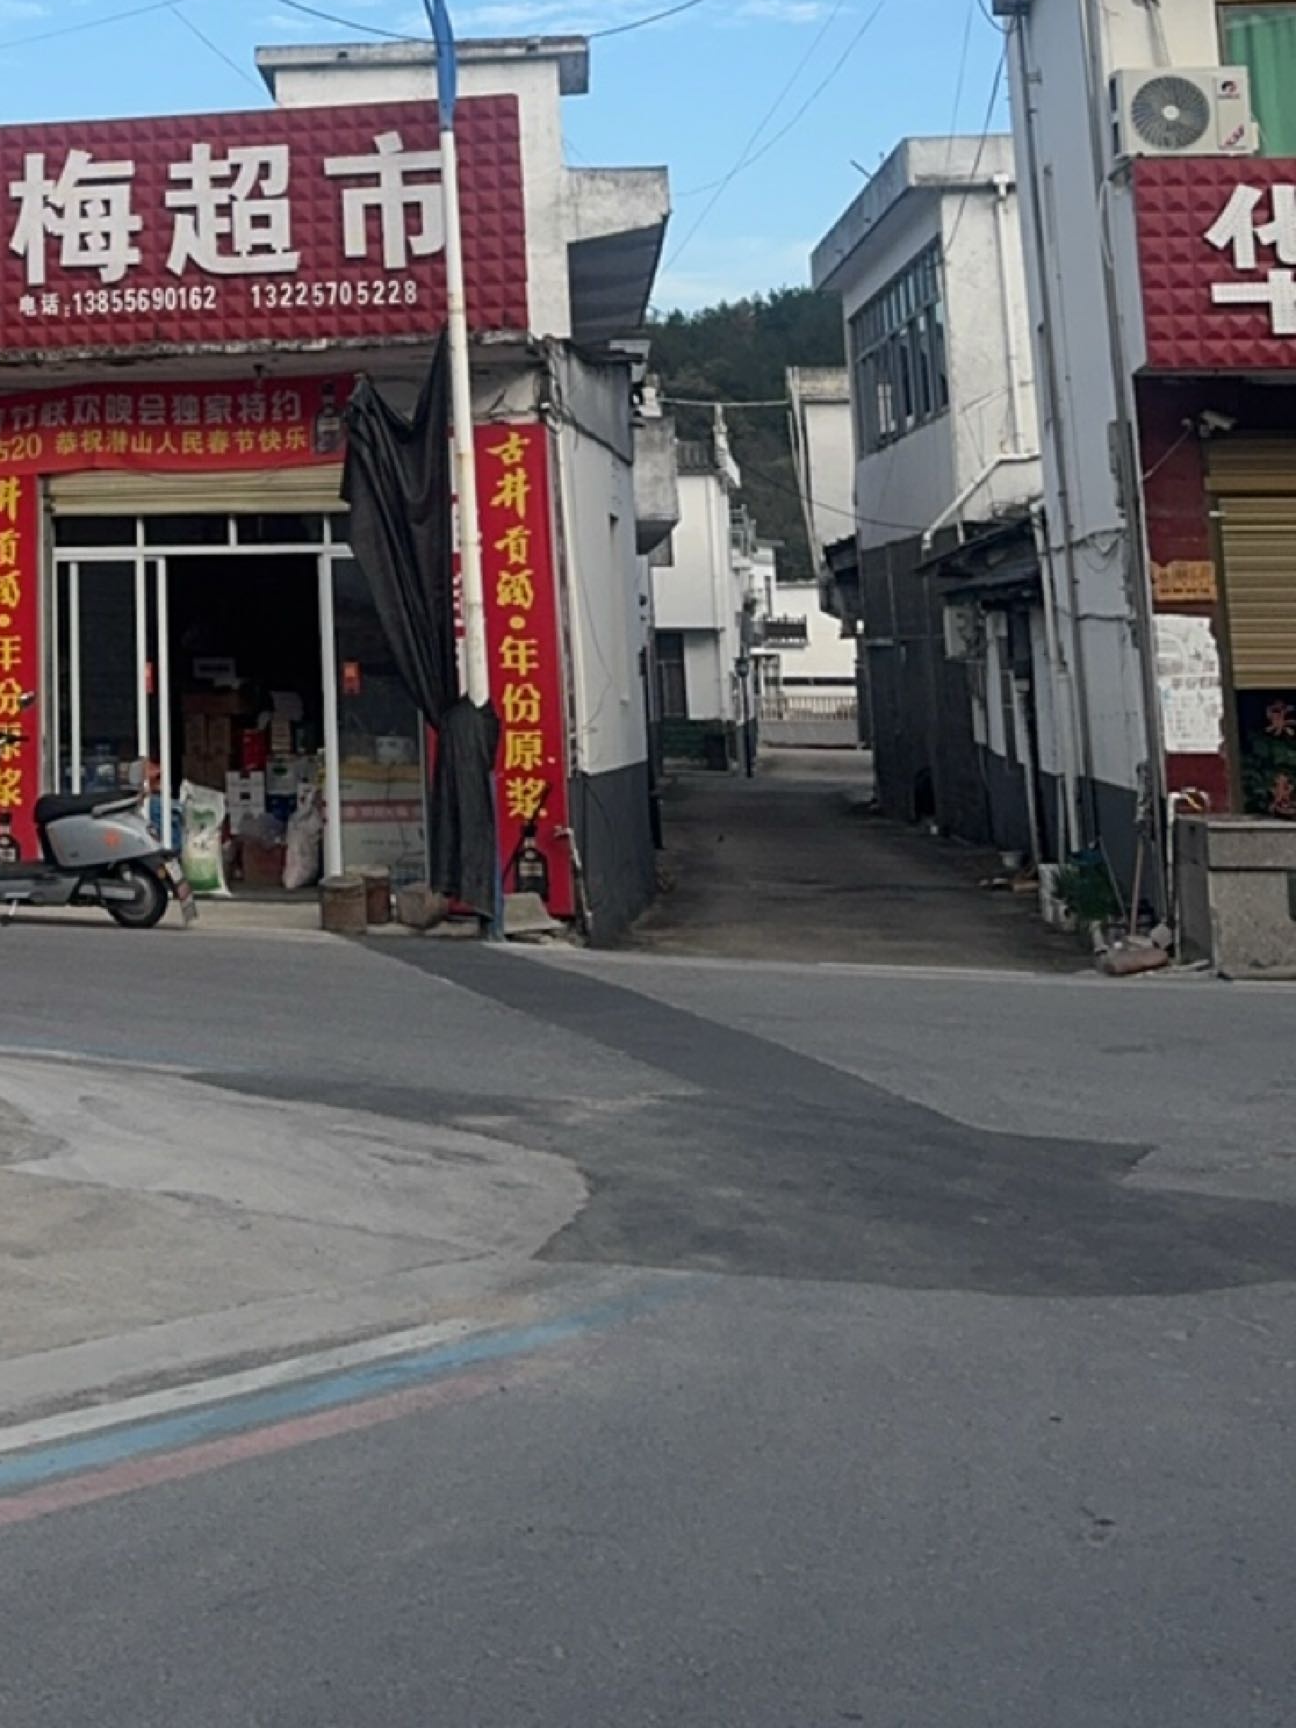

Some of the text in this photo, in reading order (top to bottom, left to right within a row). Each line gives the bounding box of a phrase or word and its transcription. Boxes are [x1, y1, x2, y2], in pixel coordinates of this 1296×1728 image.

[250, 280, 418, 309] 13225705228
[55, 424, 308, 456] 恭祝潜山人民春节快乐
